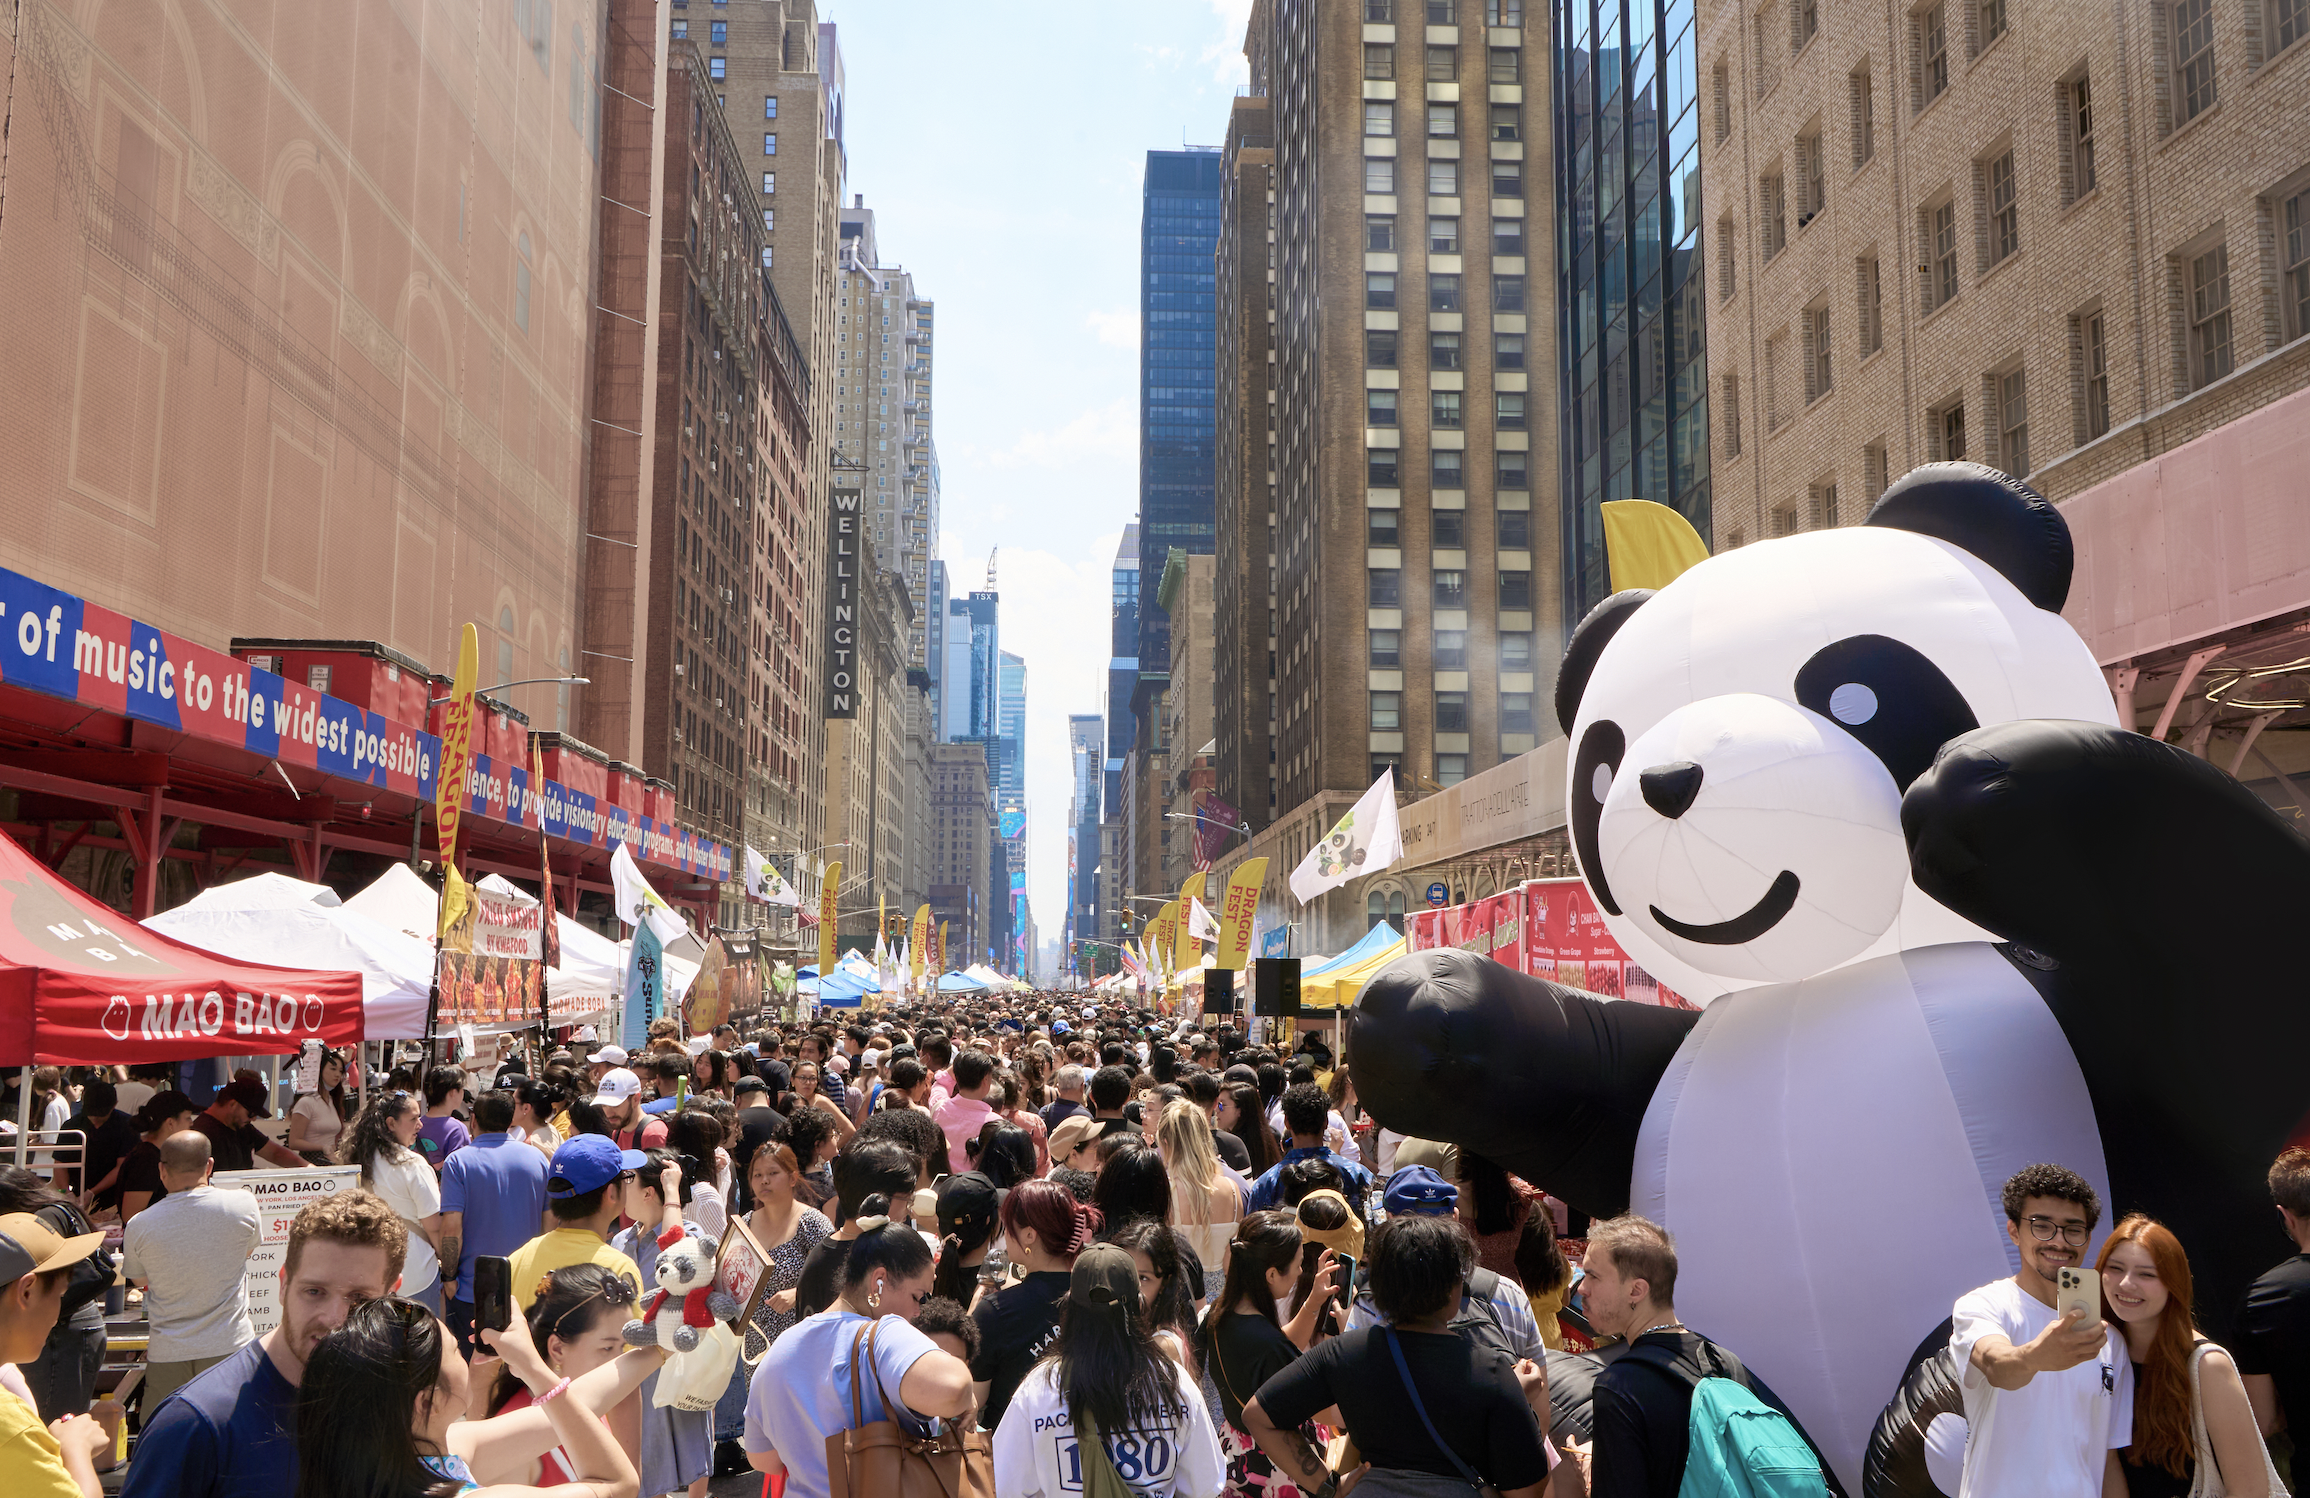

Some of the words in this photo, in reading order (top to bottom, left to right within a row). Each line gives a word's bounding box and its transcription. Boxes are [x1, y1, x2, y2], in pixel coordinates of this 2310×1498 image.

[832, 494, 859, 712] WELLINGTON
[18, 604, 62, 663] of
[73, 628, 176, 700] music
[184, 659, 213, 711] to
[222, 672, 265, 728] the
[273, 692, 349, 756] widest
[353, 728, 430, 781] possible
[507, 777, 520, 809] to
[564, 794, 607, 841] visionary
[606, 812, 643, 846] education
[643, 829, 675, 862] programs,
[675, 837, 687, 860] and
[687, 841, 693, 862] to
[693, 842, 709, 867] foster
[708, 848, 717, 869] the
[717, 850, 731, 873] future
[478, 898, 504, 927] FRIED
[823, 888, 832, 926] FEST
[1180, 896, 1192, 928] FEST
[1226, 885, 1244, 923] FEST
[1158, 919, 1167, 944] FEST
[1235, 886, 1258, 953] DRAGON
[1492, 915, 1518, 951] Juice
[486, 933, 495, 952] BY
[495, 935, 528, 955] KWAFOOD
[916, 922, 926, 964] DRAGON
[929, 937, 938, 959] BAO
[1593, 946, 1615, 957] Strawberry
[140, 991, 225, 1041] MAO
[234, 991, 298, 1035] BAO
[587, 997, 606, 1012] BOBA
[254, 1183, 288, 1195] MAO
[292, 1181, 322, 1193] BAO
[246, 1270, 278, 1280] HICK
[249, 1289, 270, 1298] EEF
[248, 1306, 270, 1315] AMB
[1029, 1324, 1062, 1358] HAR
[684, 1394, 698, 1403] WE
[1034, 1412, 1073, 1433] PAC
[1064, 1435, 1170, 1483] 180
